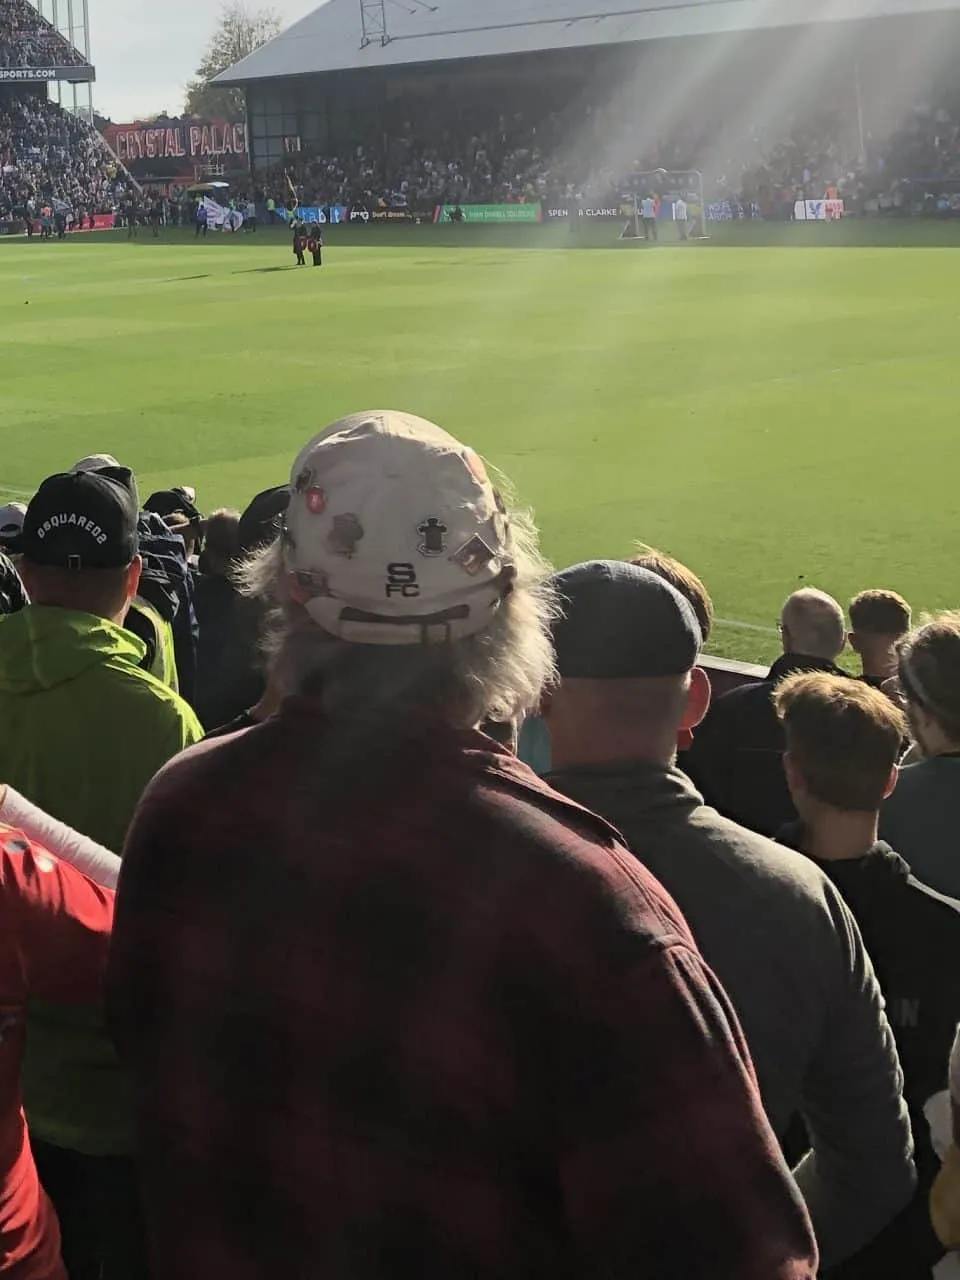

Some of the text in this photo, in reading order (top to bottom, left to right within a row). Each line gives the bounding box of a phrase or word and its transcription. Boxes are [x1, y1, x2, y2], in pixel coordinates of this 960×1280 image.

[116, 127, 185, 159] CRYSTAL
[548, 209, 583, 217] SPENR
[585, 208, 617, 216] CLARKE
